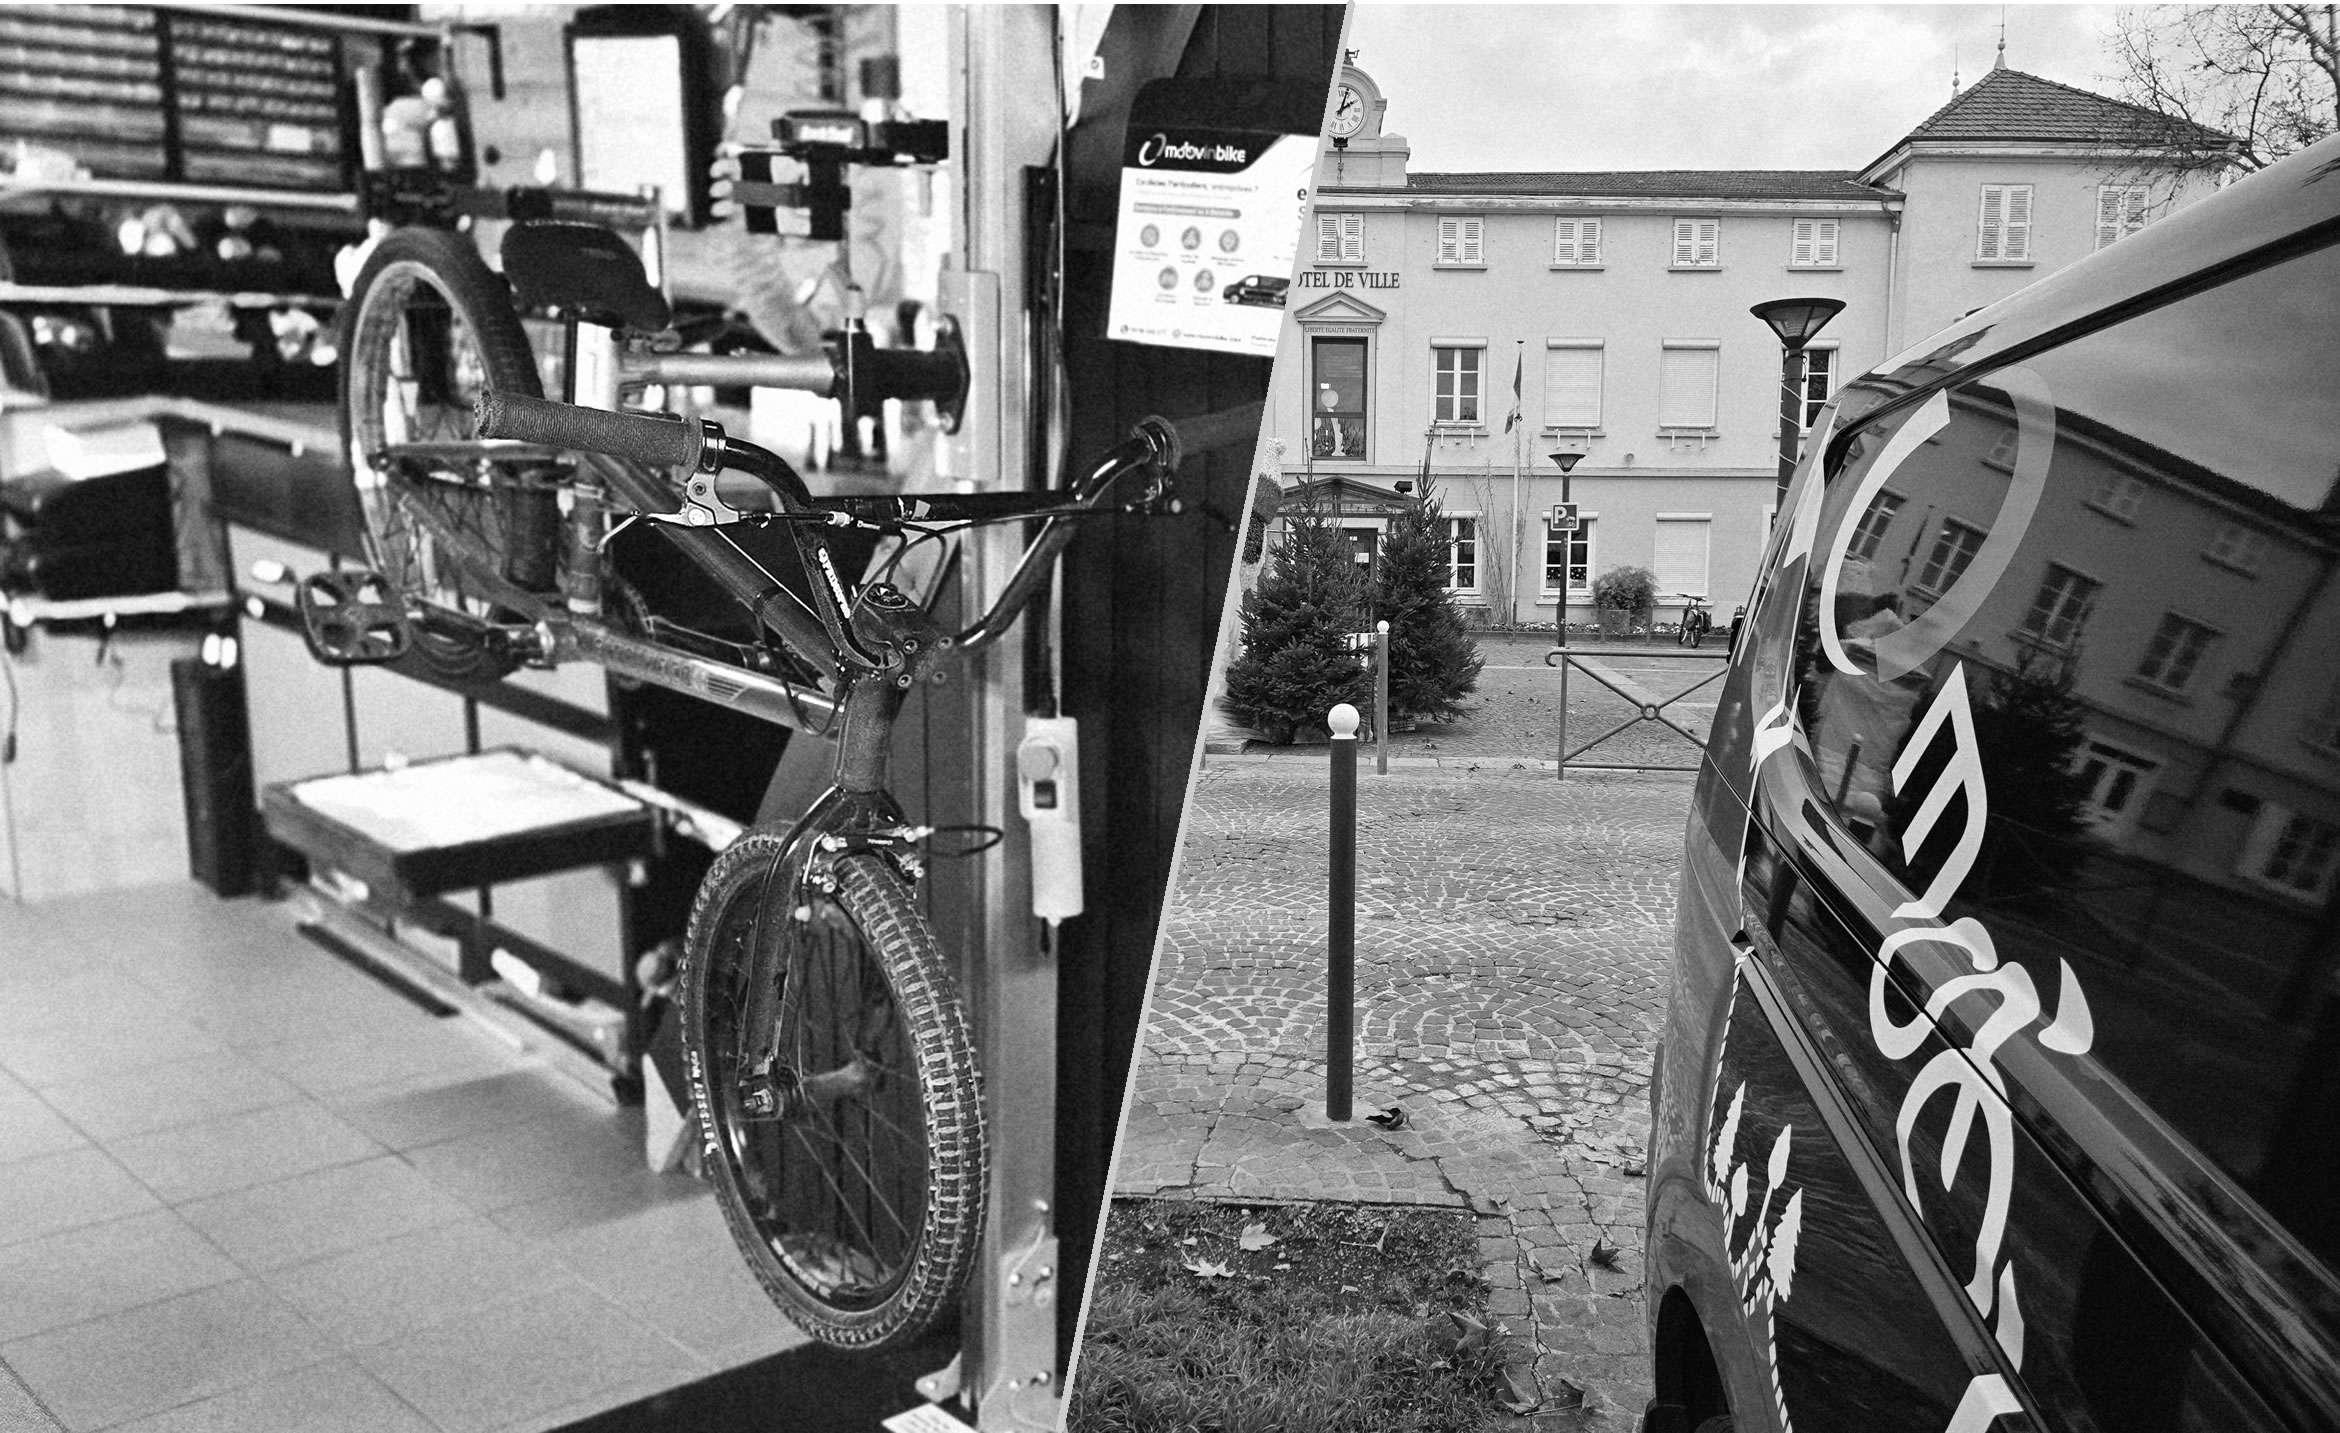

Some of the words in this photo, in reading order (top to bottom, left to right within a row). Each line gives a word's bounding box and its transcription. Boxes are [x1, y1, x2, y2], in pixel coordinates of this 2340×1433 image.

[1164, 140, 1246, 163] moovinbike
[1334, 272, 1354, 288] DE
[1358, 272, 1400, 289] VILLE
[1554, 506, 1567, 524] P
